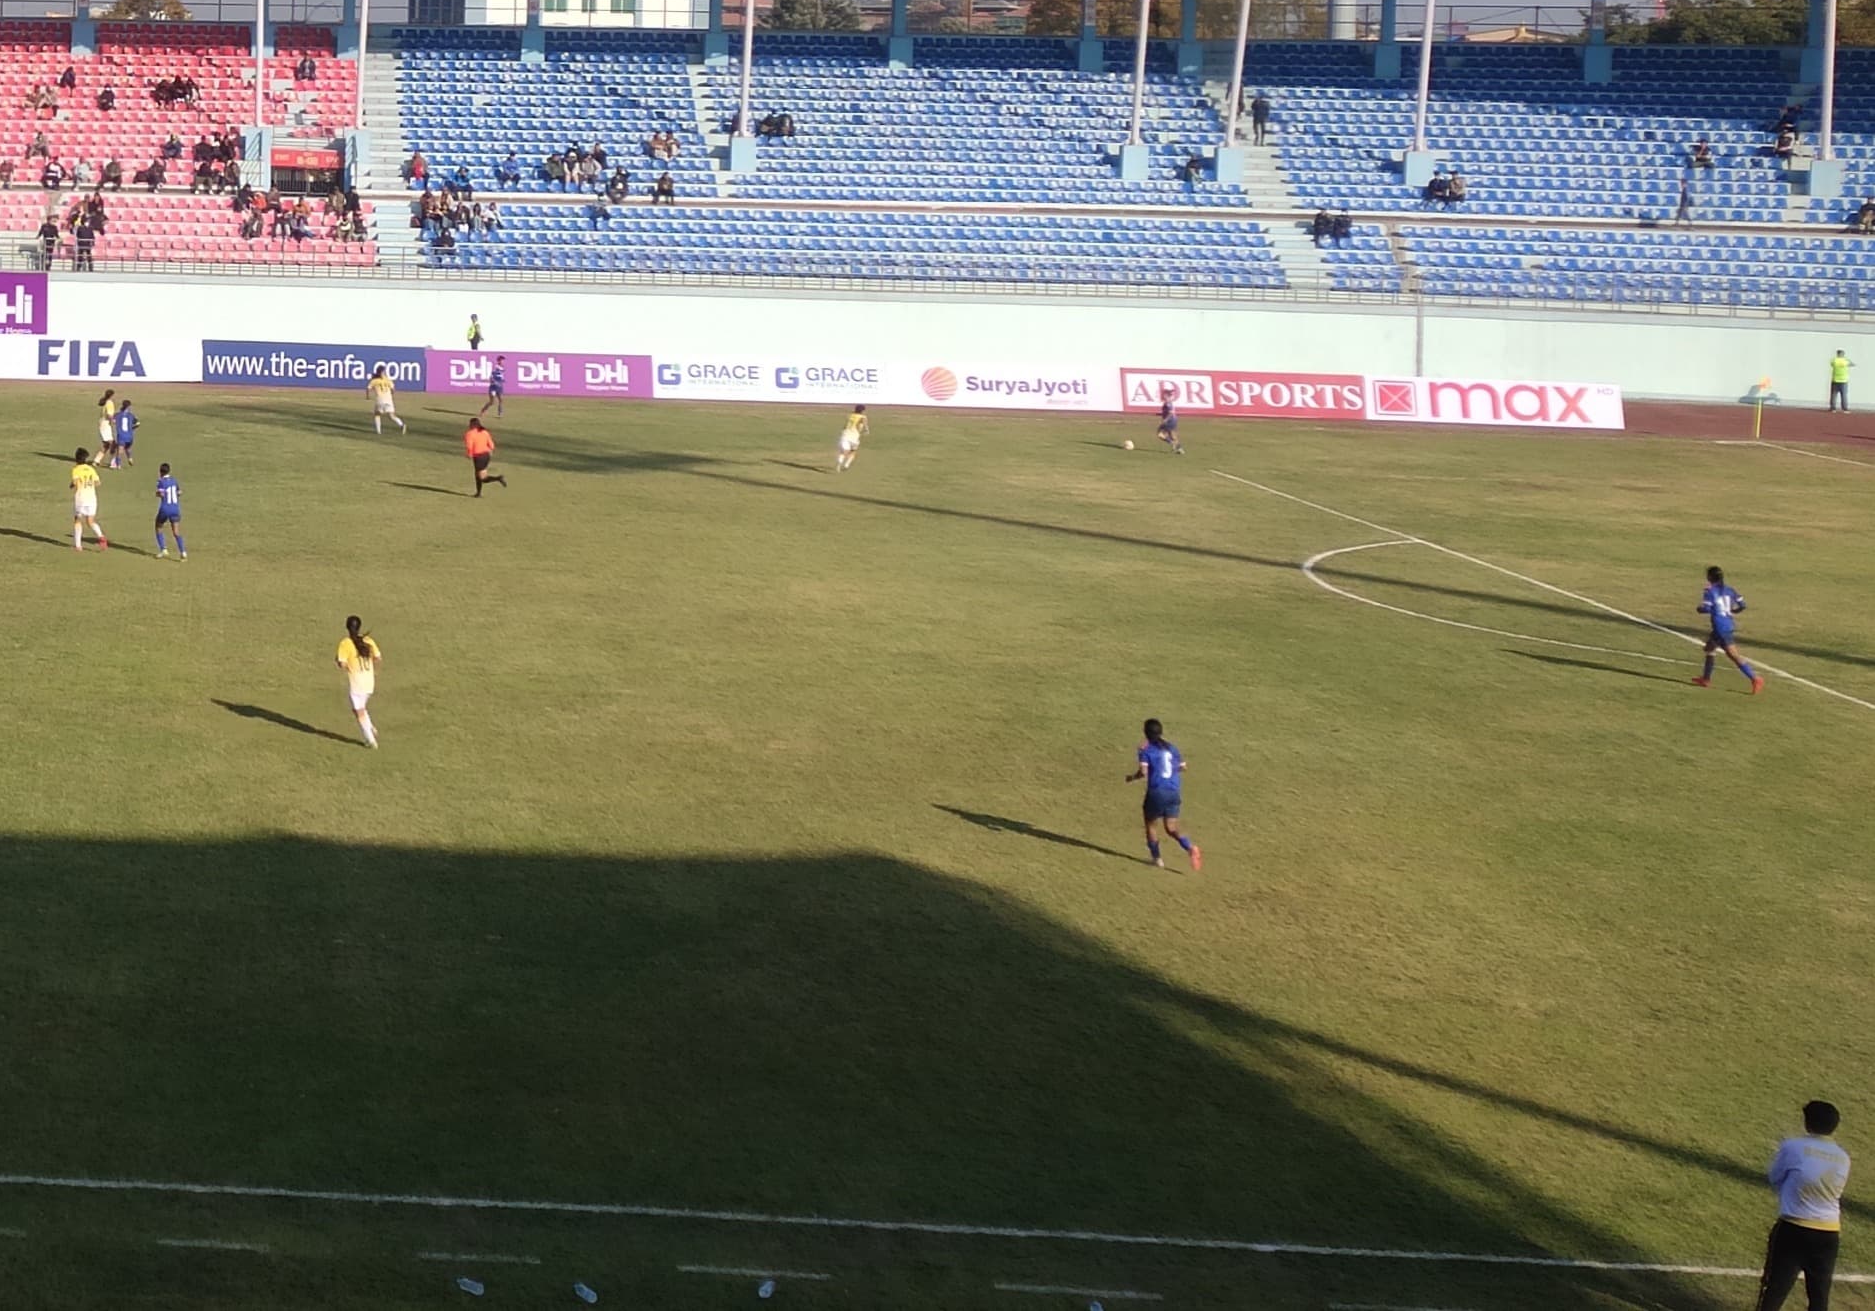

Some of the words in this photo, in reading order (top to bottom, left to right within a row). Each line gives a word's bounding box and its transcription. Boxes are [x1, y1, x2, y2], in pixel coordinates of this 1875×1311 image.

[37, 339, 147, 377] FIFA
[207, 351, 421, 381] www.the-anfa.com
[687, 364, 759, 379] GRACE
[805, 367, 879, 382] GRACE
[966, 375, 1087, 396] SuryaJyoti
[1131, 379, 1212, 405] ADR
[1219, 380, 1364, 411] SPORTS
[1428, 381, 1593, 423] max
